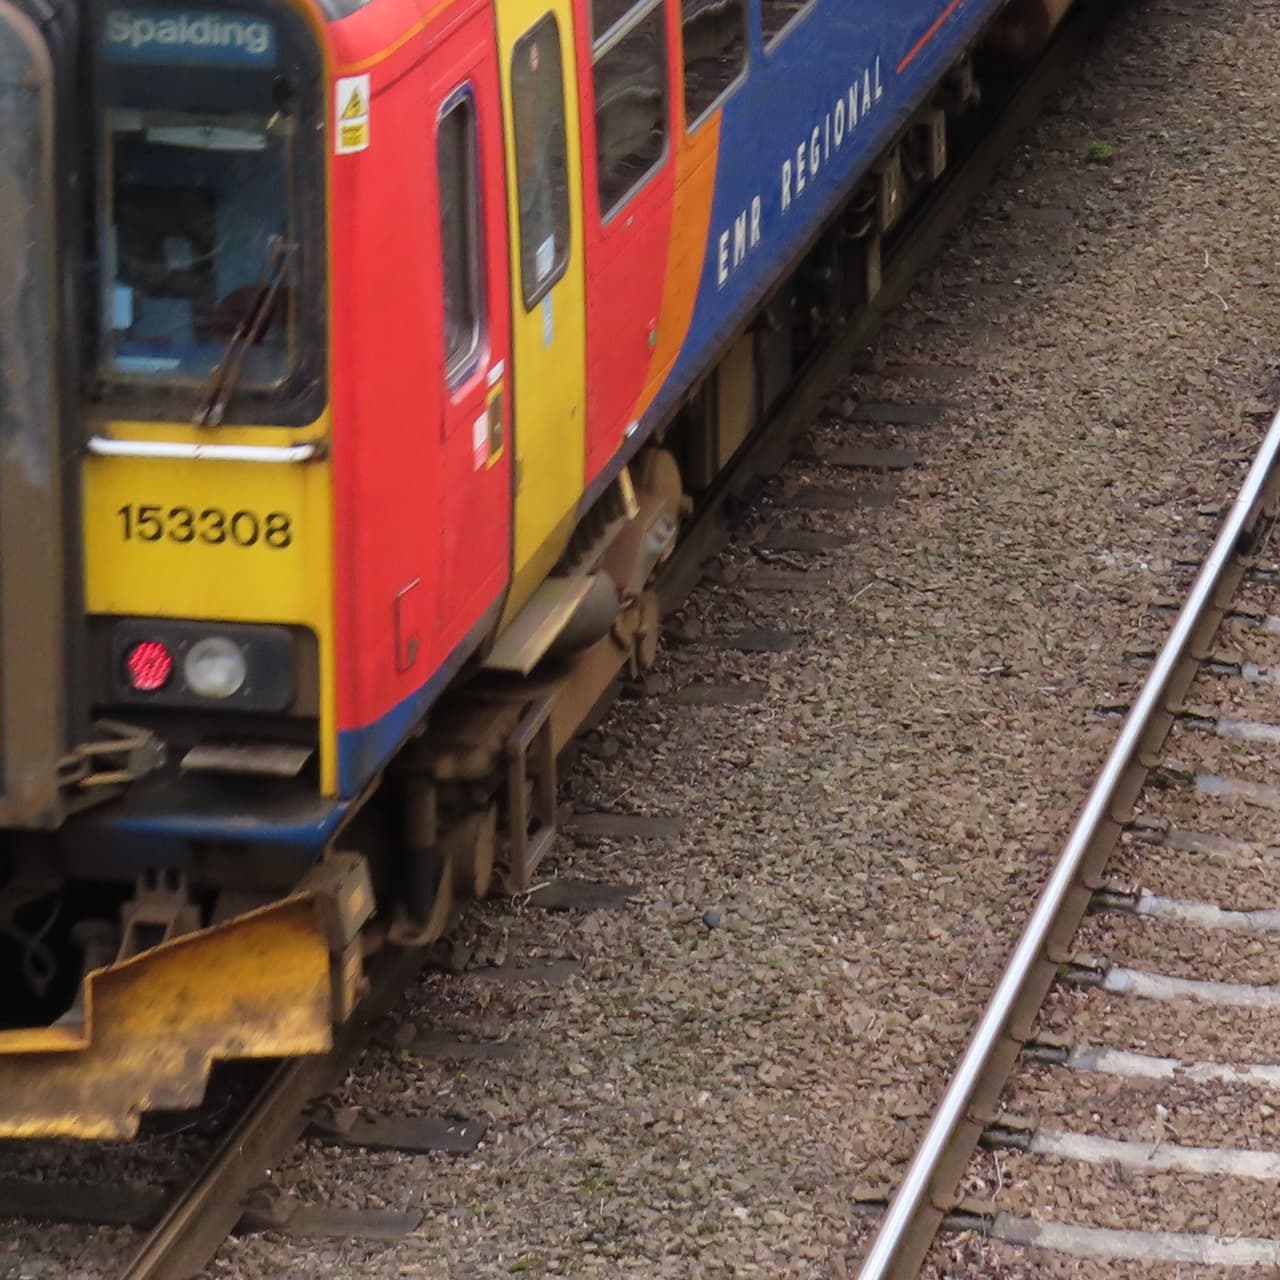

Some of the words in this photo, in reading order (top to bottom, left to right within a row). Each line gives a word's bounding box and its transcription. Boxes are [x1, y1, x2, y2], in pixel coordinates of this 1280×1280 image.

[107, 11, 269, 54] Spalding
[717, 195, 761, 288] EMR
[780, 55, 884, 213] REGIONAL
[118, 503, 292, 549] 153308
